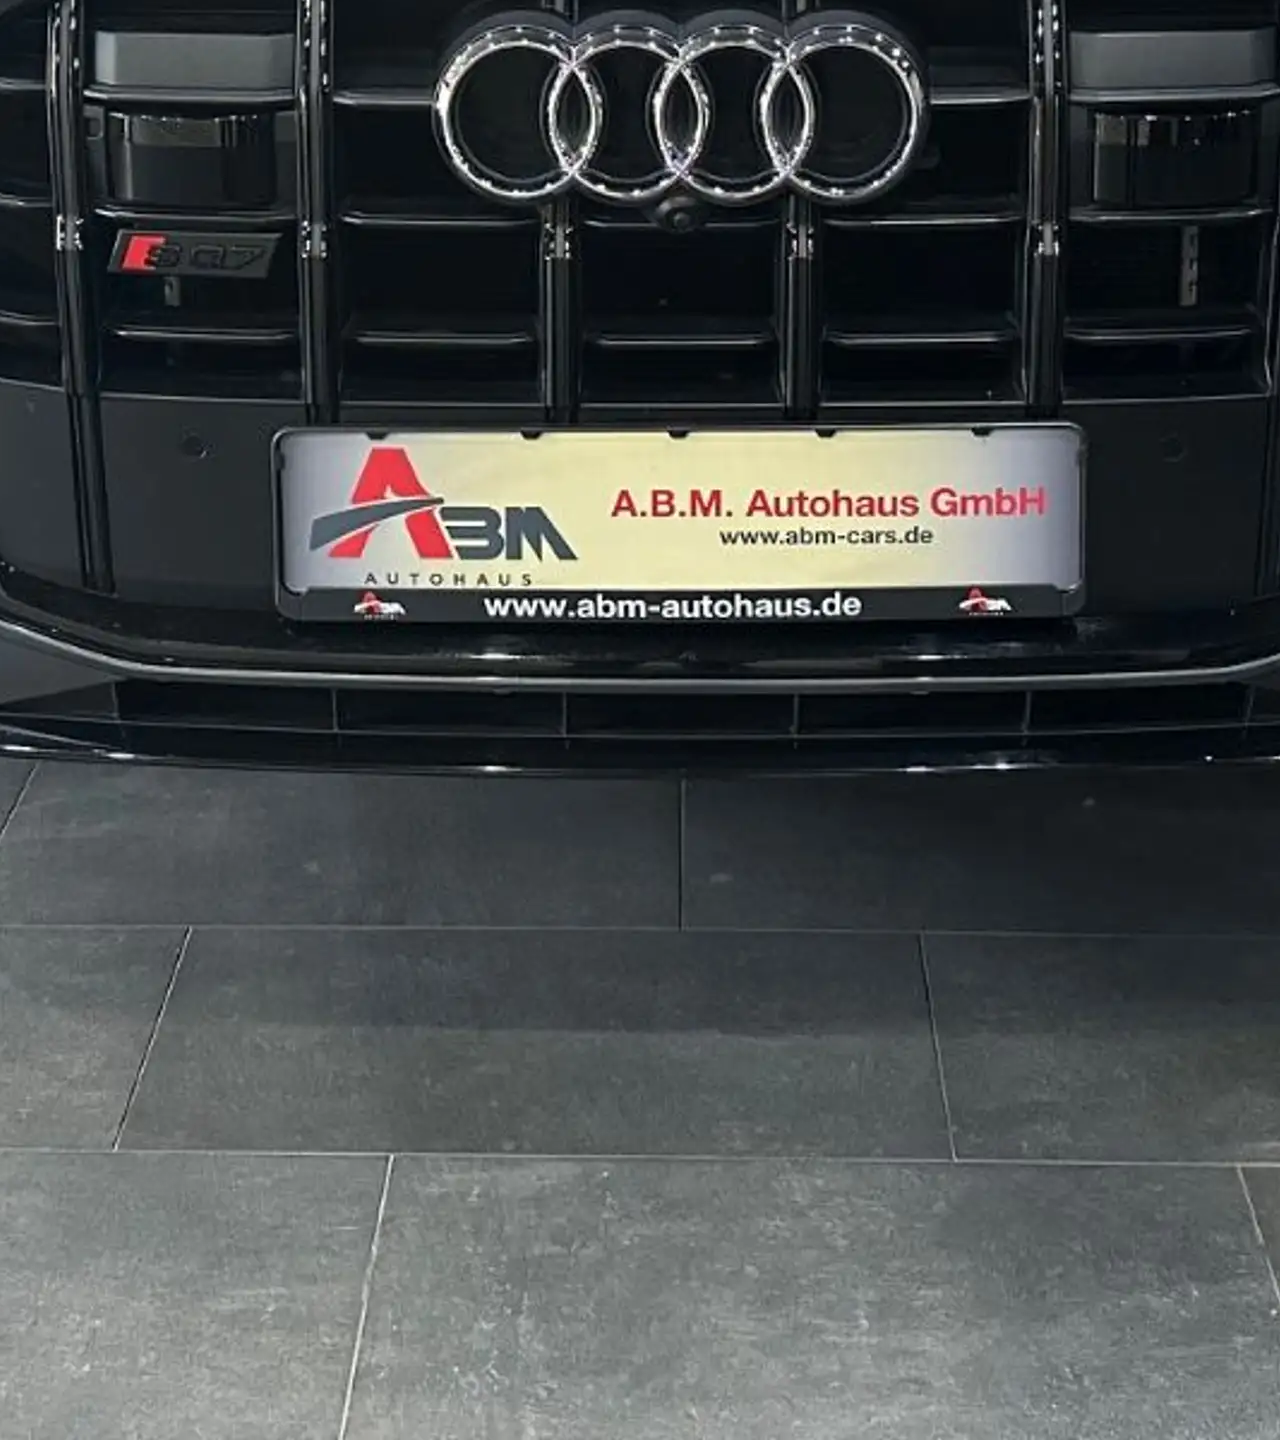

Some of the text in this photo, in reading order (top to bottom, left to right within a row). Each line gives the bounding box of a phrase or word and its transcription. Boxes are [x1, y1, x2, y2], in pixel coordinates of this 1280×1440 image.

[309, 447, 579, 562] ABM
[611, 487, 1048, 517] A.B.M. Autohaus GmbH
[719, 526, 934, 546] www.abm-cars.de
[364, 571, 533, 587] AUTOHAUS
[483, 591, 862, 619] www.abm-autohaus.de
